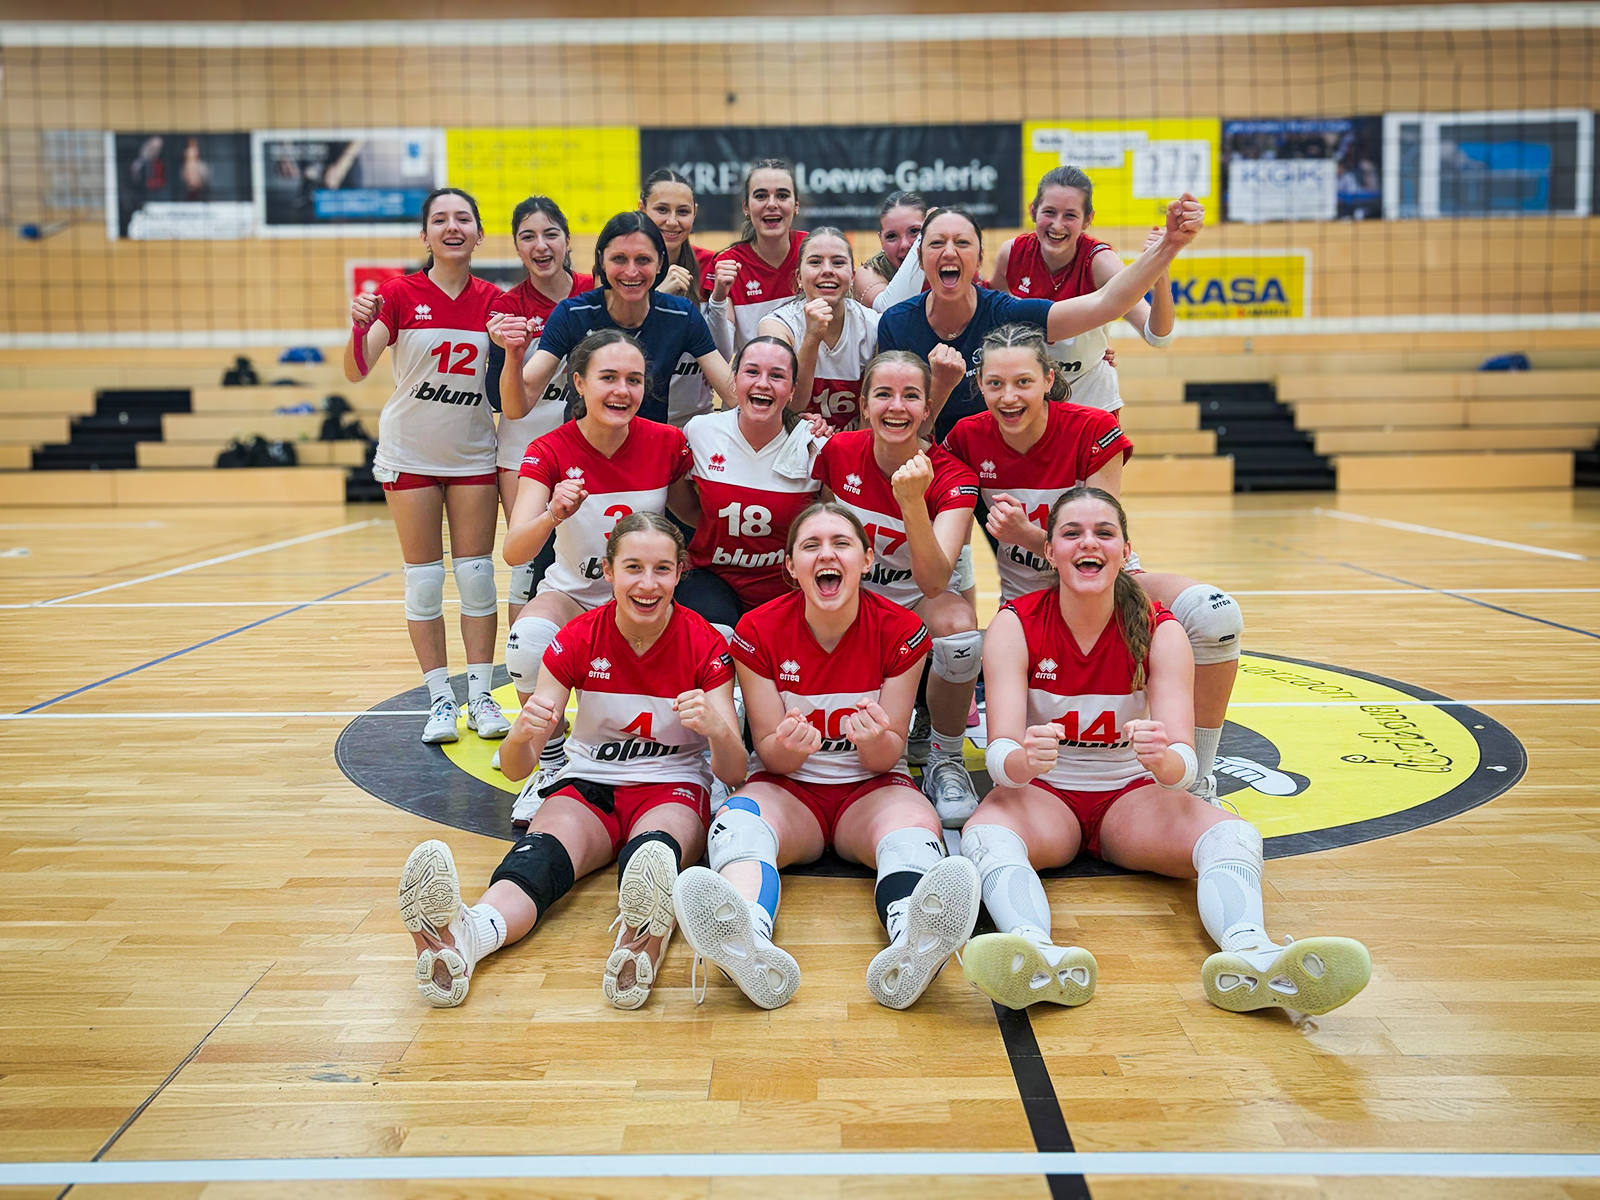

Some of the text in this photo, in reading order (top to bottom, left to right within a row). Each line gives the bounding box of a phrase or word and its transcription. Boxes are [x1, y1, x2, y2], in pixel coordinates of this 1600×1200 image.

[669, 158, 998, 196] KRE Loewe-Galerie
[1144, 277, 1287, 306] KASA
[414, 313, 433, 321] errea
[431, 341, 479, 377] 12
[415, 382, 483, 407] blum
[812, 390, 857, 419] 16
[979, 471, 997, 479] errea
[842, 483, 862, 496] errea
[718, 502, 772, 538] 18
[711, 546, 785, 568] blum
[1010, 544, 1058, 573] blu
[588, 669, 611, 680] errea
[779, 672, 800, 683] errea
[1035, 671, 1057, 681] errea
[1051, 710, 1122, 744] 14
